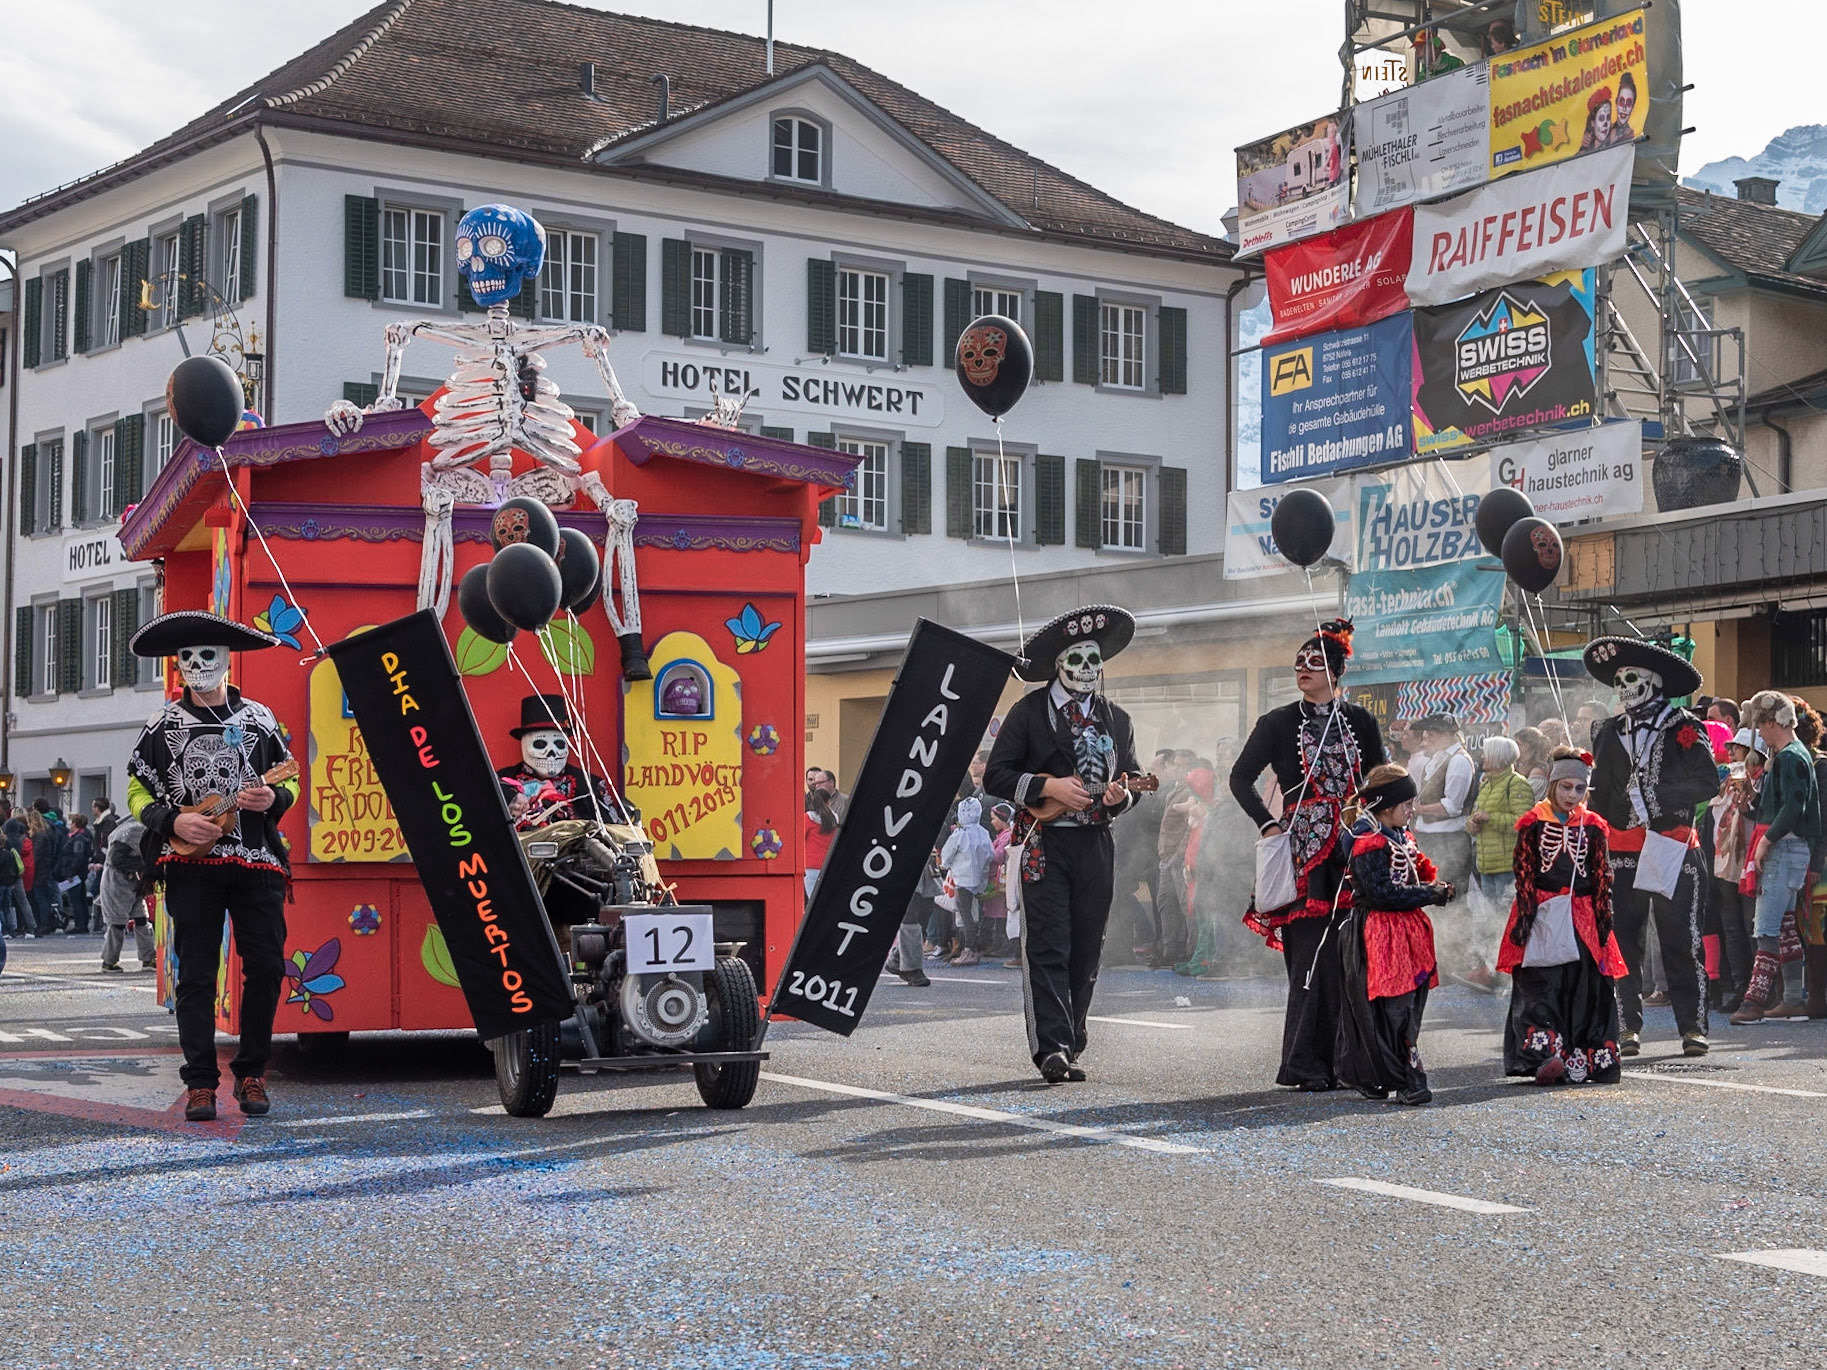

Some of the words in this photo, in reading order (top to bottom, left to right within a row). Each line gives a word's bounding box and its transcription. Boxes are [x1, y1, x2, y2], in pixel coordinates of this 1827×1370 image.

[1538, 0, 1585, 27] STEIN
[1492, 51, 1549, 81] Fasnacht
[1549, 45, 1567, 64] im
[1568, 17, 1644, 57] Glarnerland
[1493, 40, 1645, 128] fasnachtskalender.ch
[1437, 120, 1486, 140] Blechverarbeitung
[1361, 134, 1418, 163] MÜHLETHALER
[1439, 137, 1480, 157] Laserschneiden
[1243, 231, 1273, 248] Dethleffs
[1428, 184, 1615, 275] RAIFFEISEN
[1290, 258, 1361, 296] WUNDERLE
[1365, 251, 1382, 273] AG
[1280, 302, 1315, 318] BADEWELTEN
[1460, 324, 1547, 368] SWISS
[1273, 353, 1311, 391] FA
[1322, 374, 1333, 384] Fax
[1460, 353, 1546, 381] WERBETECHNIK
[661, 361, 760, 397] HOTEL
[782, 375, 924, 416] SCHWERT
[1292, 401, 1304, 414] Ihr
[1304, 389, 1366, 413] Ansprechpartner
[1367, 384, 1378, 397] für
[1298, 417, 1332, 436] gesamte
[1333, 404, 1386, 425] Gebäudehülle
[1418, 399, 1590, 448] swiss-werbetechnik.ch
[1270, 444, 1304, 473] Fischli
[1307, 431, 1384, 465] Bedachungen
[1385, 424, 1404, 450] AG
[1547, 445, 1594, 472] glarner
[1528, 463, 1609, 493] haustechnik
[1613, 462, 1634, 482] ag
[1372, 494, 1481, 536] HAUSER
[69, 540, 111, 572] HOTEL
[1373, 528, 1482, 571] HOLZBA
[1375, 620, 1410, 638] Landolt
[1411, 611, 1479, 635] Gebäudetechnik
[1480, 609, 1495, 626] AG
[1432, 653, 1443, 665] Tel.
[1358, 693, 1387, 716] TEIN
[626, 761, 742, 789] LANDVÖGT
[836, 662, 960, 956] LANDVÖGT
[322, 827, 406, 855] 2009-20
[381, 652, 420, 716] DIA
[409, 726, 441, 769] DE
[431, 781, 472, 847] LOS
[459, 852, 533, 1014] MUERTOS
[644, 926, 696, 966] 12
[788, 970, 859, 1017] 2011
